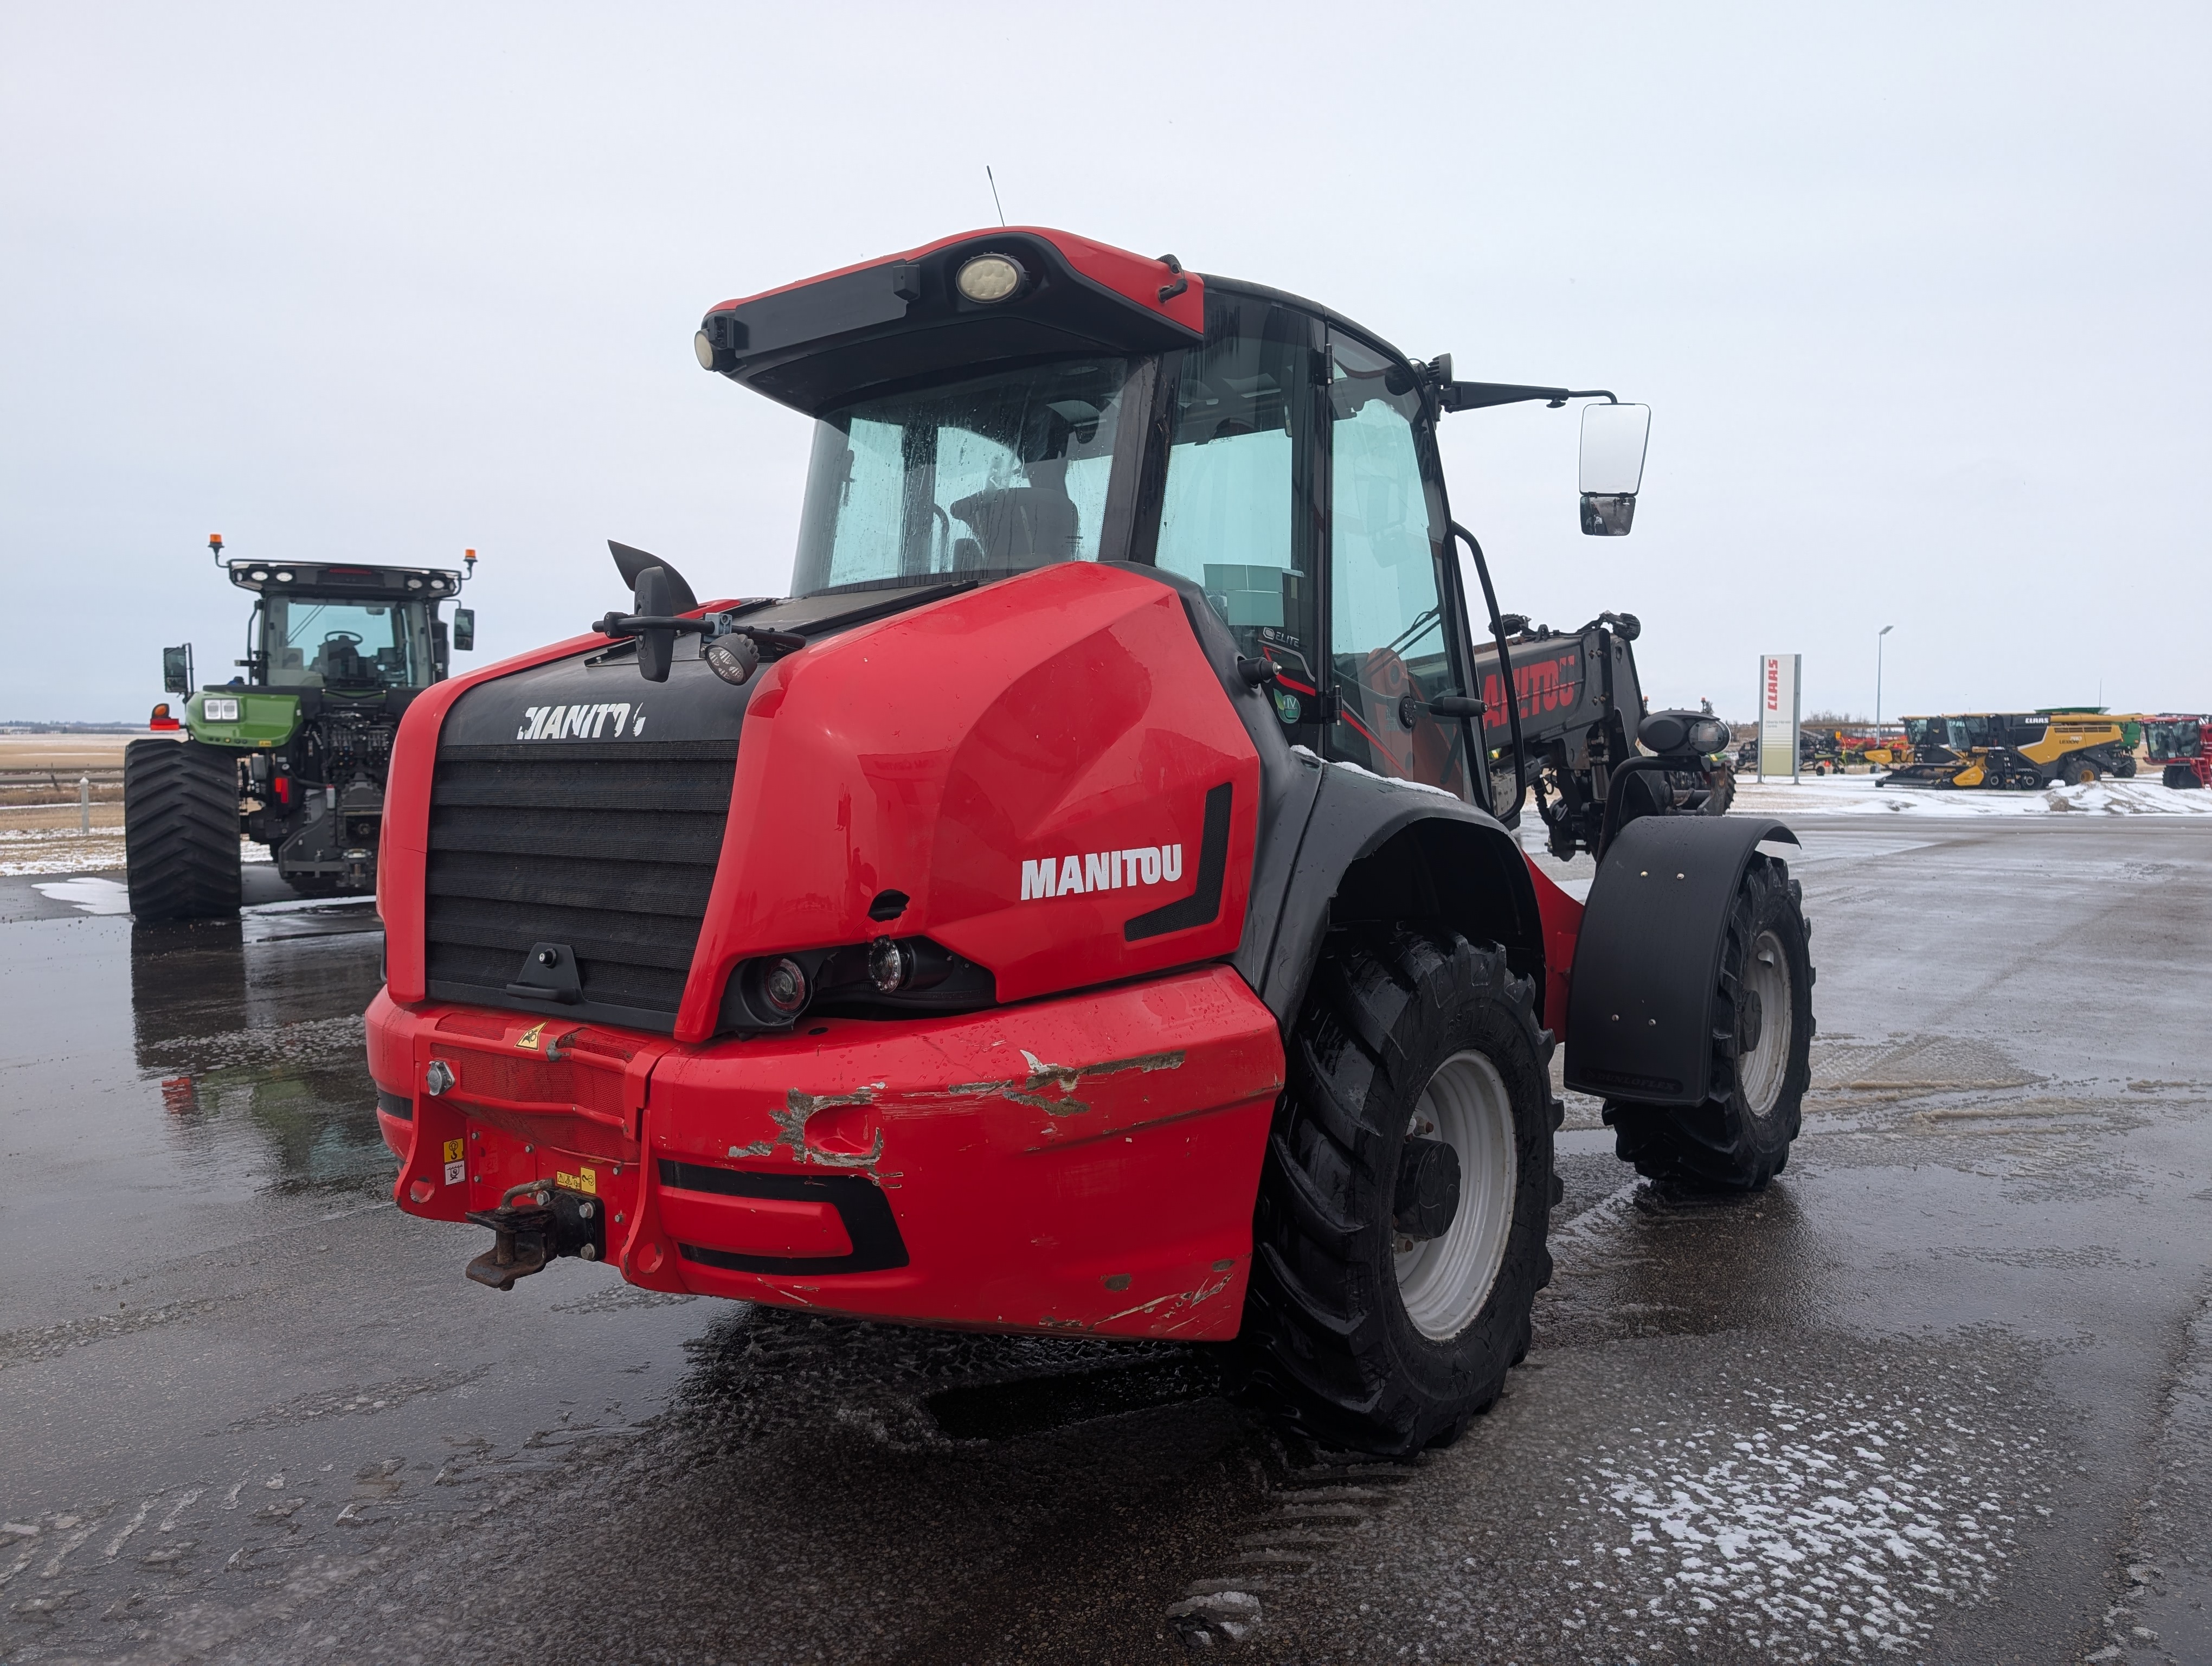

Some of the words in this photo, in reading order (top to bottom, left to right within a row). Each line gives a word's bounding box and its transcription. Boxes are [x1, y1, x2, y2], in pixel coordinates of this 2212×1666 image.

[1276, 631, 1300, 648] ELITE
[1483, 655, 1576, 730] ANITOU
[1767, 658, 1778, 711] CLAAS
[1020, 843, 1182, 901] MANITOU
